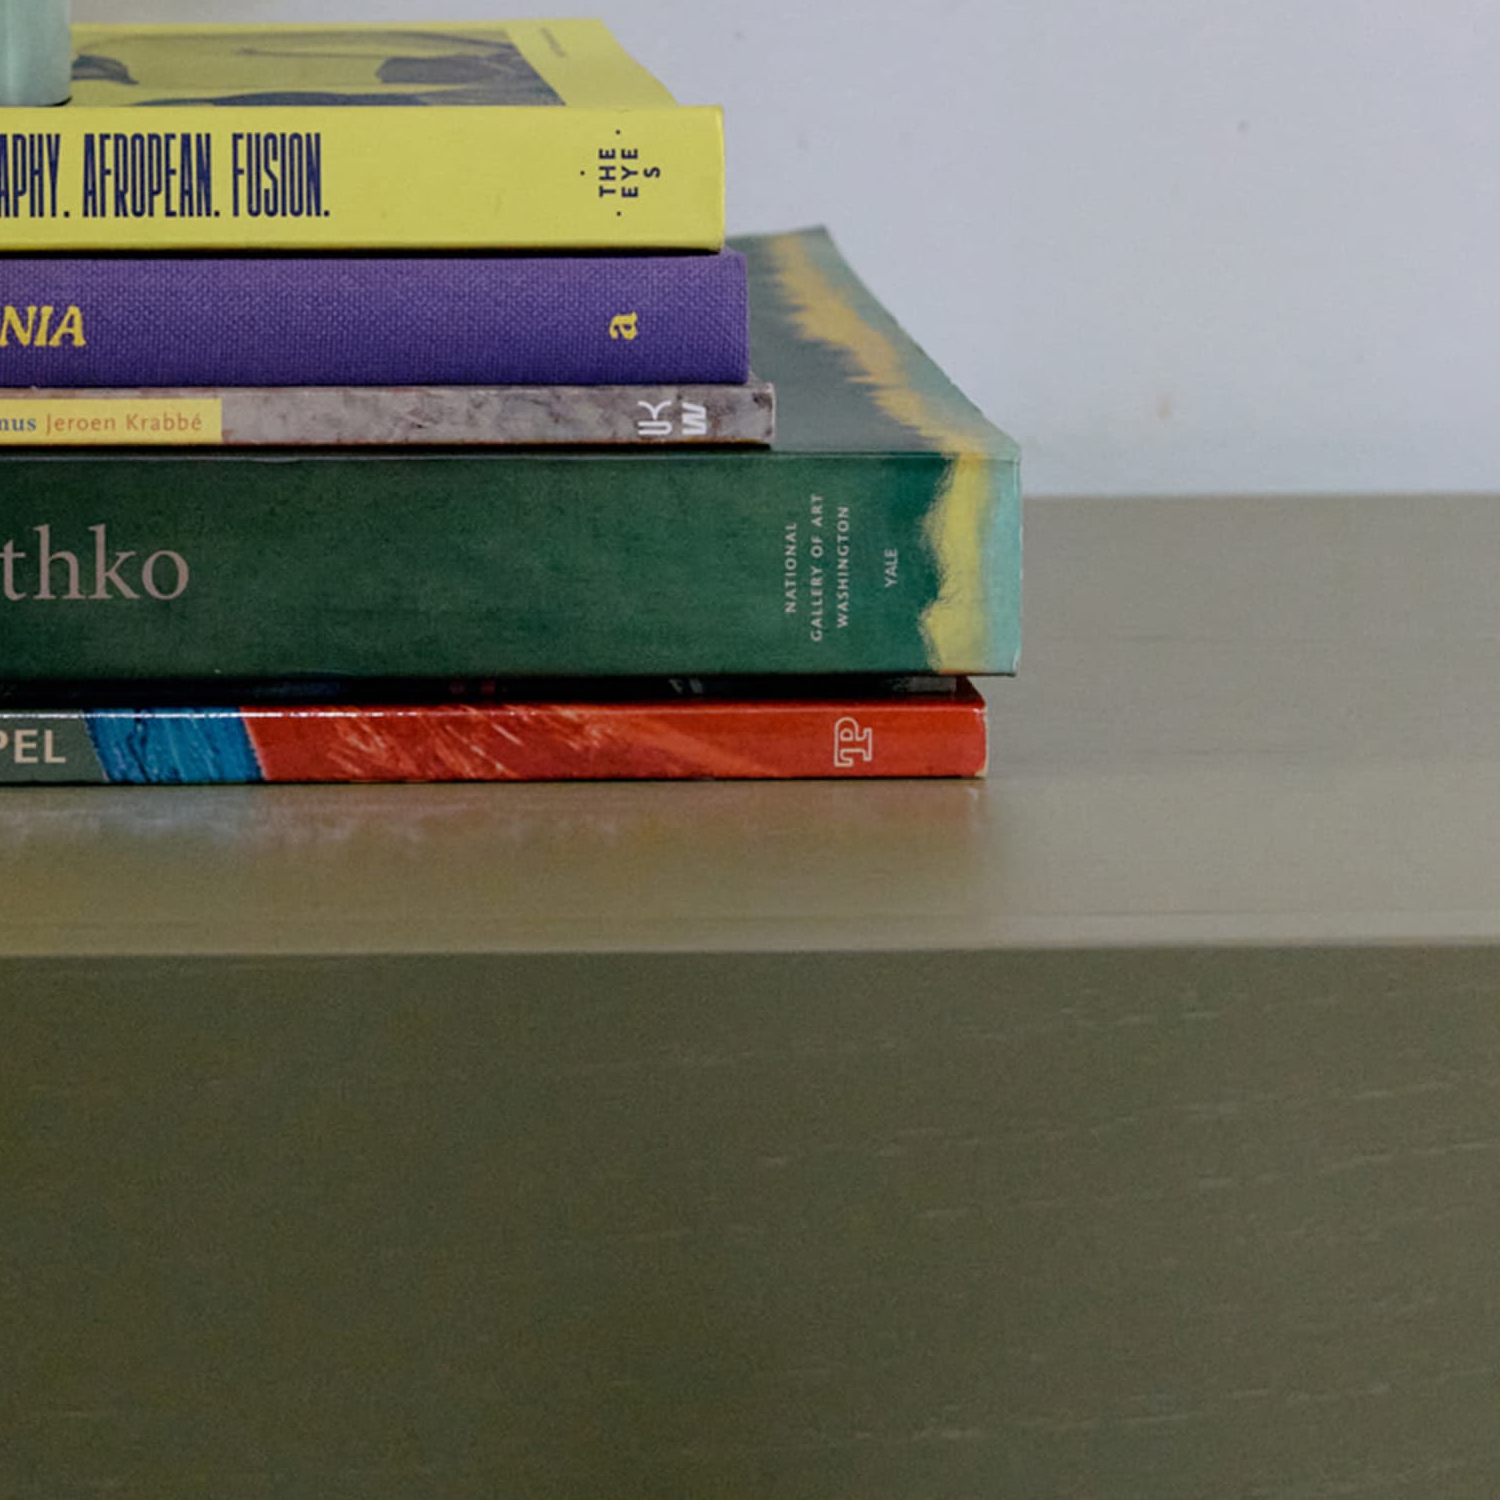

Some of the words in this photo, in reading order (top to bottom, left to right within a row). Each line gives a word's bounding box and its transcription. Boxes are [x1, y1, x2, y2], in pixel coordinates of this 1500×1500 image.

[83, 133, 221, 218] AFROPEAN.
[232, 132, 330, 218] FUSION.
[598, 148, 616, 198] THE
[46, 413, 117, 436] Jeroen
[126, 412, 203, 432] Krabbé
[810, 493, 823, 527] ART
[784, 522, 797, 614] NATIONAL
[810, 535, 823, 558] OF
[836, 506, 849, 629] WASHINGTON
[884, 548, 898, 588] YALE
[810, 565, 823, 642] GALLERY
